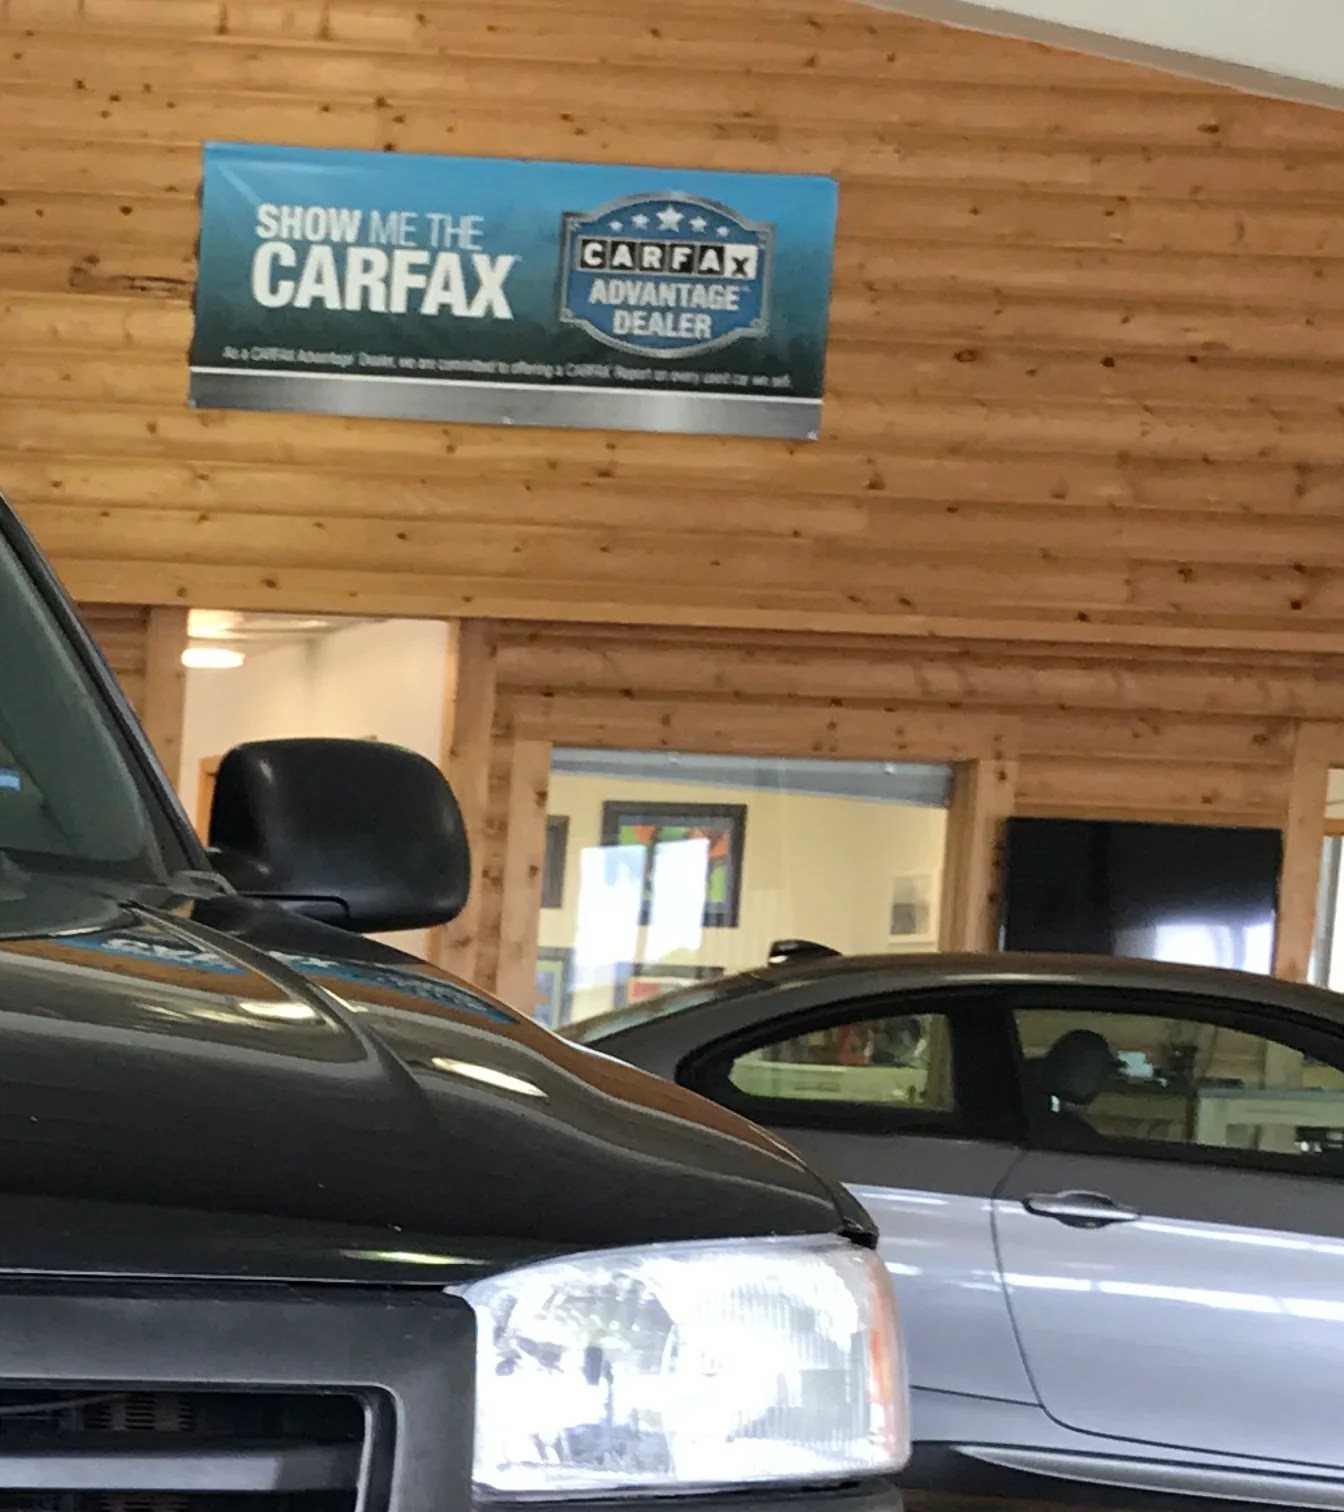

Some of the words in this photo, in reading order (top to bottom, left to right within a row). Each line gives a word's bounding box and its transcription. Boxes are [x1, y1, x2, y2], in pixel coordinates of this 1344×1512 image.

[255, 203, 362, 243] SHOW
[368, 210, 419, 247] ME
[425, 212, 485, 251] THE
[582, 242, 751, 278] CARFAX
[251, 241, 516, 320] CARFAX
[588, 278, 741, 311] ADVANTAGE
[613, 310, 712, 339] DEALER
